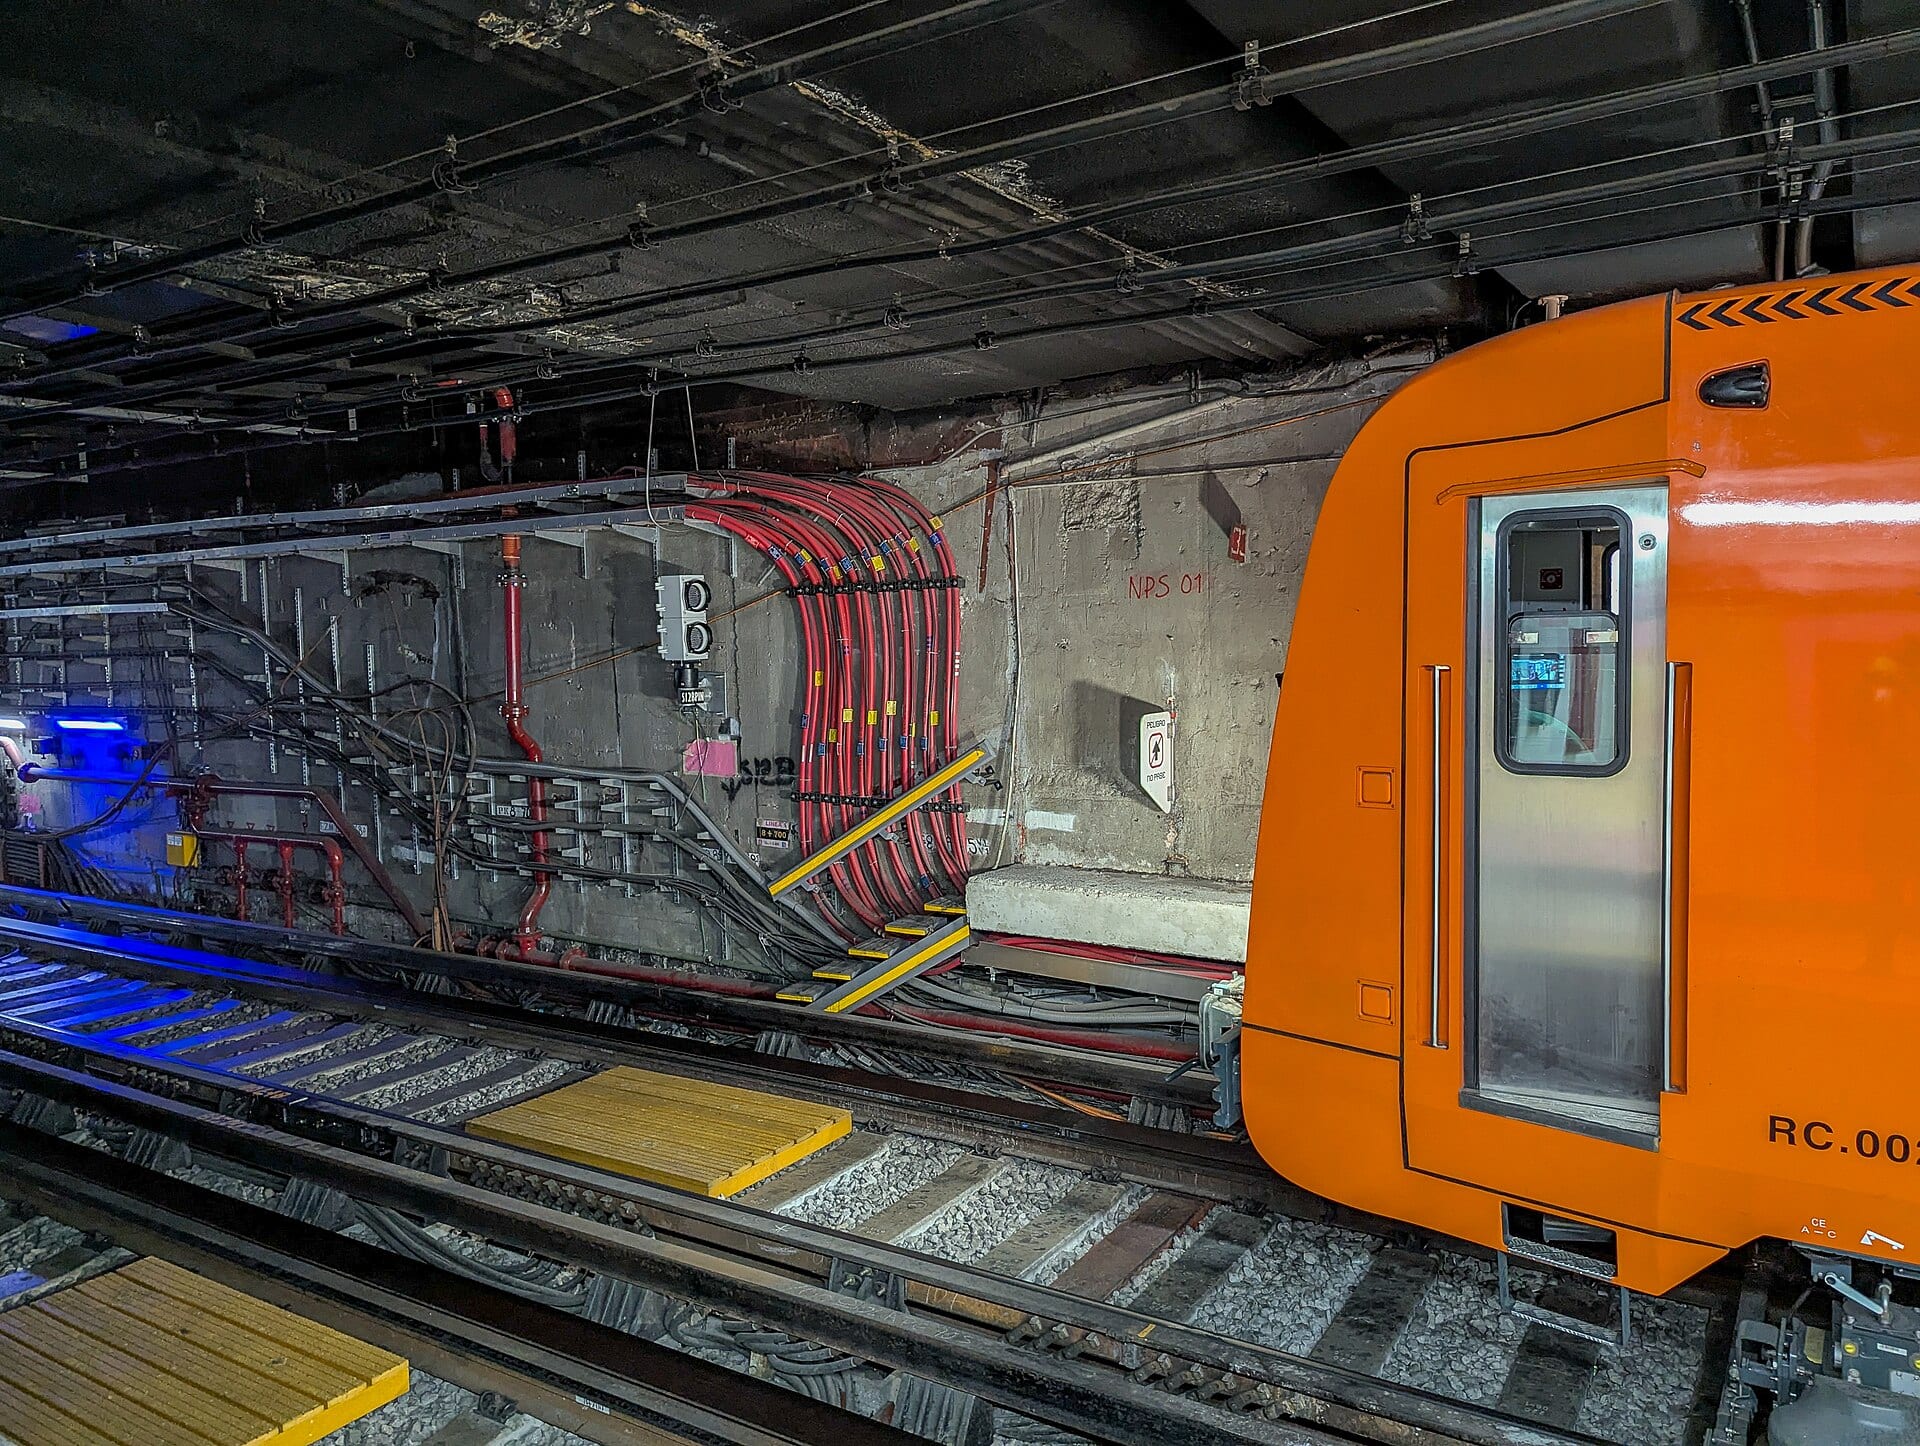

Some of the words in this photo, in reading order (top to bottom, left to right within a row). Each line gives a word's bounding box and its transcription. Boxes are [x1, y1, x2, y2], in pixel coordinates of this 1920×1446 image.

[1129, 574, 1170, 599] NPS
[1181, 573, 1202, 594] 01
[1768, 1114, 1920, 1166] RC.00
[1811, 1218, 1826, 1228] CE
